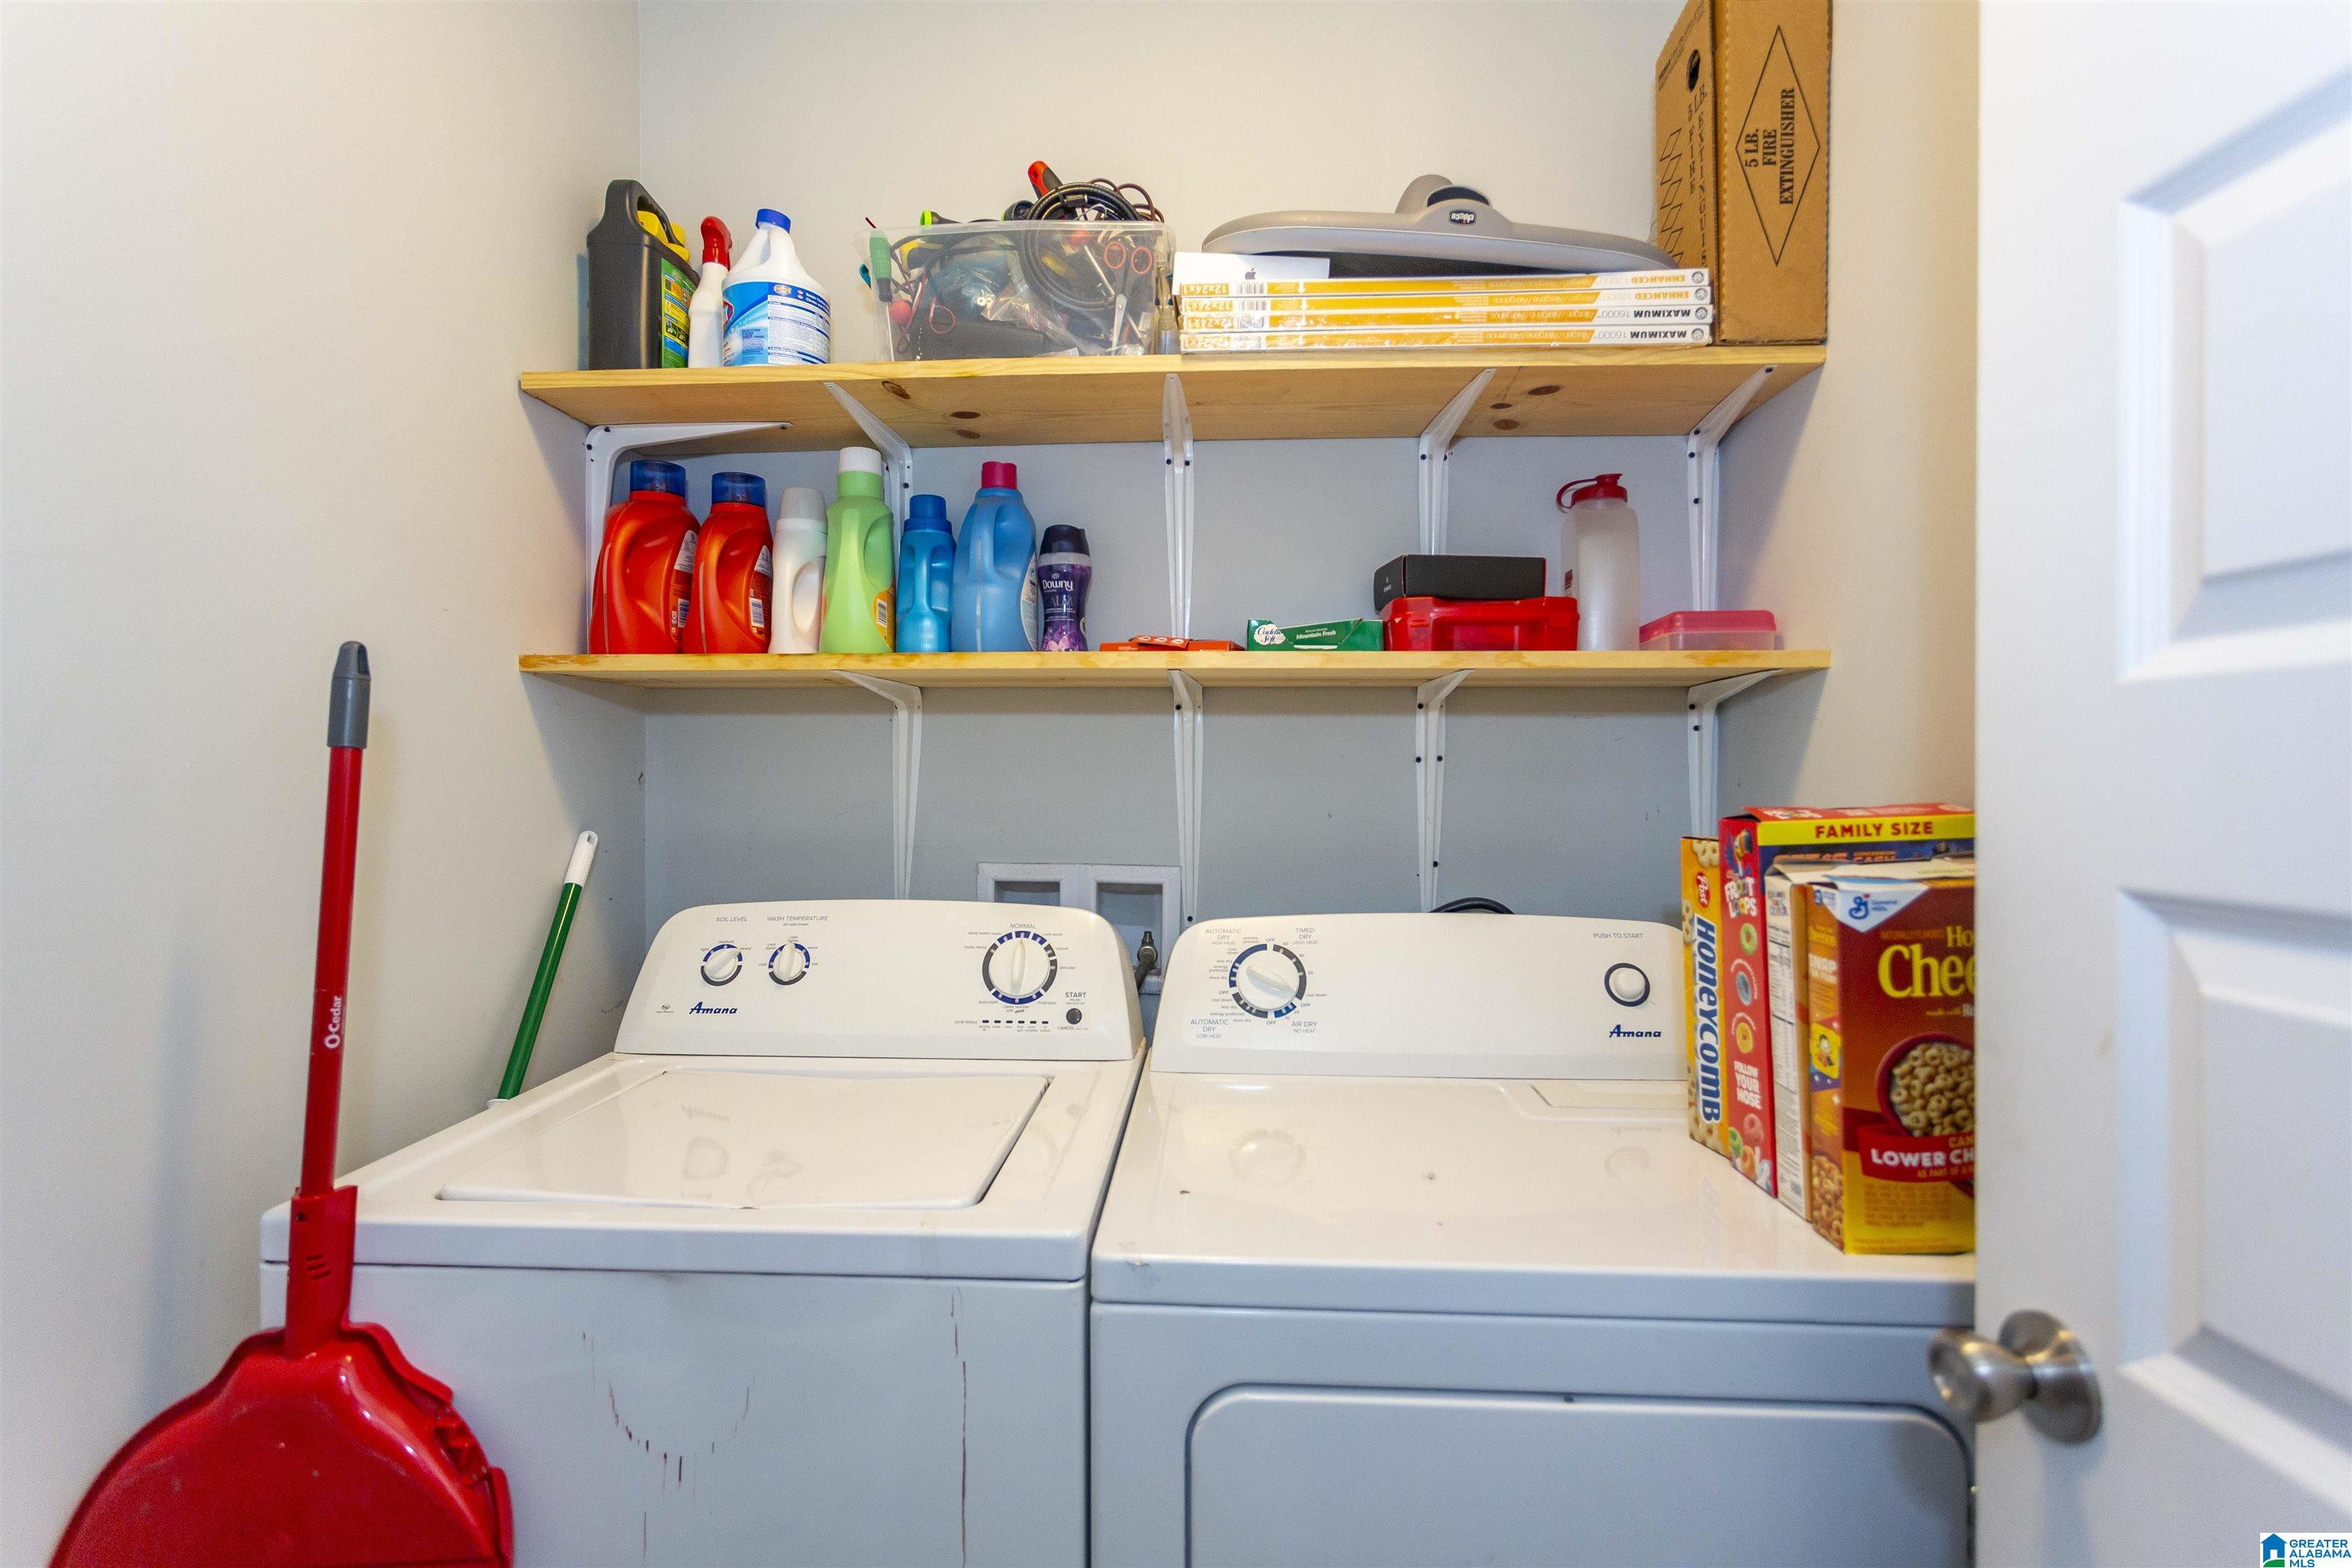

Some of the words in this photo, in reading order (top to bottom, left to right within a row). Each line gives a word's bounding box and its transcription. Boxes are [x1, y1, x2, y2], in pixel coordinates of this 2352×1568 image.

[1745, 129, 1759, 153] LB.
[1762, 129, 1776, 166] FIRE
[1780, 88, 1795, 204] EXTINGUISHER
[1745, 158, 1759, 168] 5
[1698, 111, 1707, 268] EXTINGUIS
[1451, 213, 1475, 224] chicco
[1632, 275, 1685, 283] ENHANCED
[1635, 291, 1690, 300] ENHANCED
[1633, 309, 1690, 318] MAXIMUM
[1630, 330, 1687, 339] MAXIMUM
[1042, 580, 1073, 592] Downy
[1261, 635, 1276, 643] Soft
[1815, 823, 1882, 838] FAMILY
[1891, 822, 1933, 835] SIZE
[1697, 874, 1708, 905] Post
[1945, 926, 1975, 948] Ho
[689, 1001, 737, 1014] Amana
[324, 995, 342, 1048] O-Cedar
[1609, 1024, 1661, 1038] Amana
[1870, 1148, 1945, 1168] LOWER
[1949, 1148, 1975, 1165] CH
